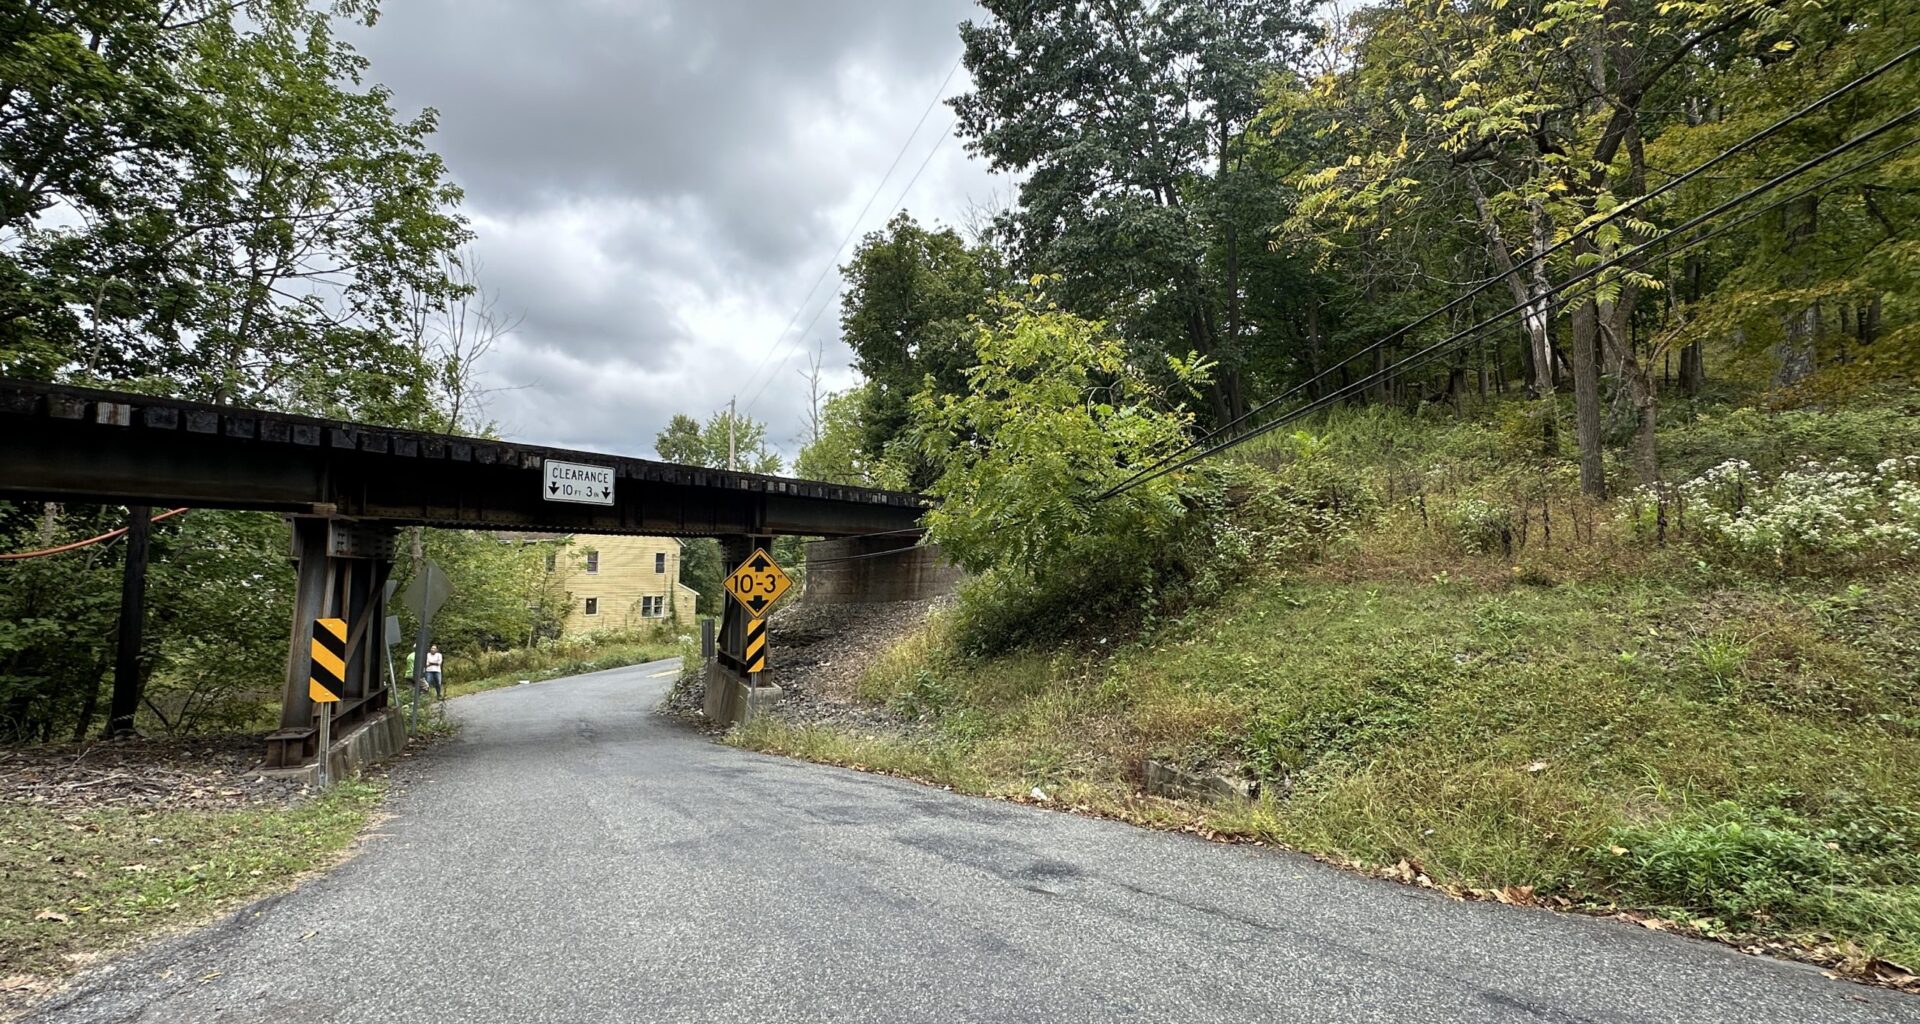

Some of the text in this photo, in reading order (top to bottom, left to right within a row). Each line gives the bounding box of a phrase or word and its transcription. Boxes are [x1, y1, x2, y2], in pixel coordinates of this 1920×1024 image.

[552, 467, 608, 483] CLEARANCE
[562, 484, 573, 496] 10
[586, 486, 593, 497] 3
